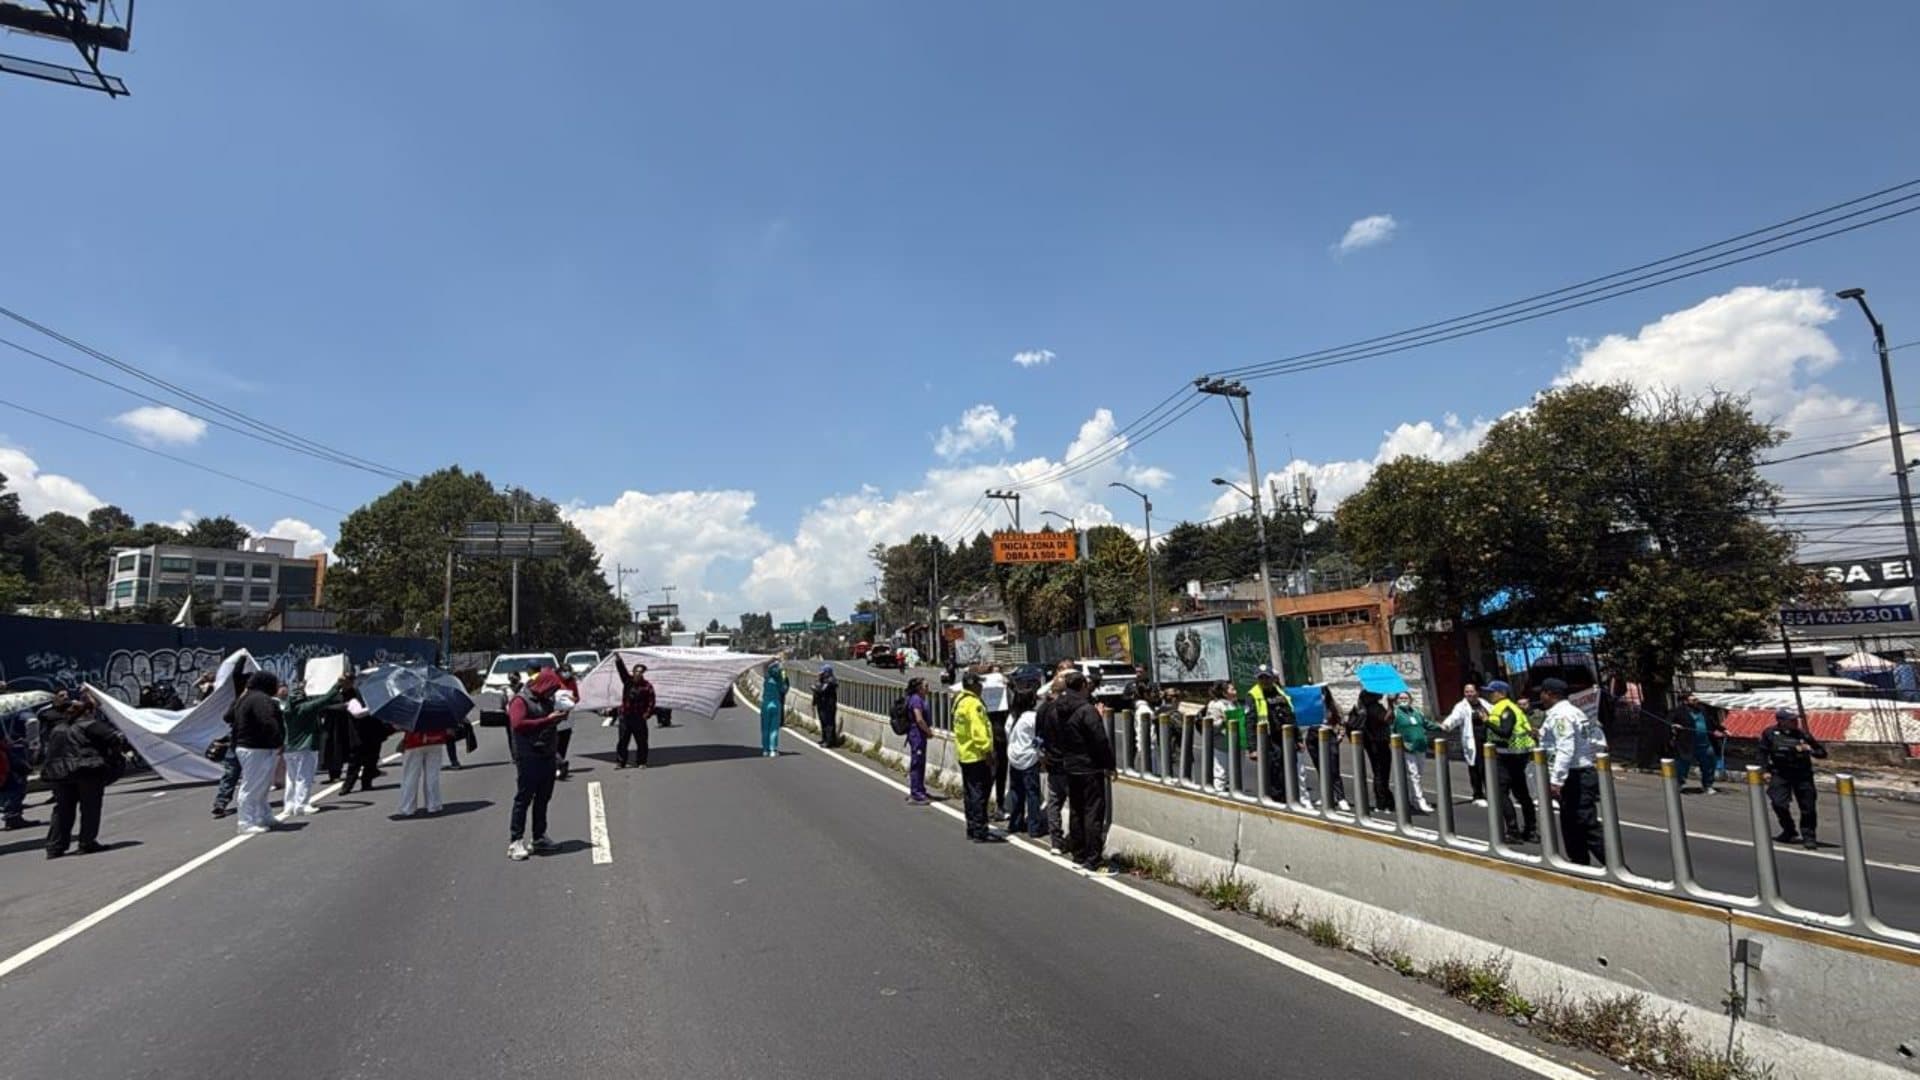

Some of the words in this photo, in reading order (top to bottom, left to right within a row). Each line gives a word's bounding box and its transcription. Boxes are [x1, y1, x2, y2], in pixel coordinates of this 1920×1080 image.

[1001, 542, 1028, 550] INICIA
[1057, 541, 1068, 549] DE
[1006, 552, 1029, 560] OBRA
[1809, 565, 1872, 584] SA
